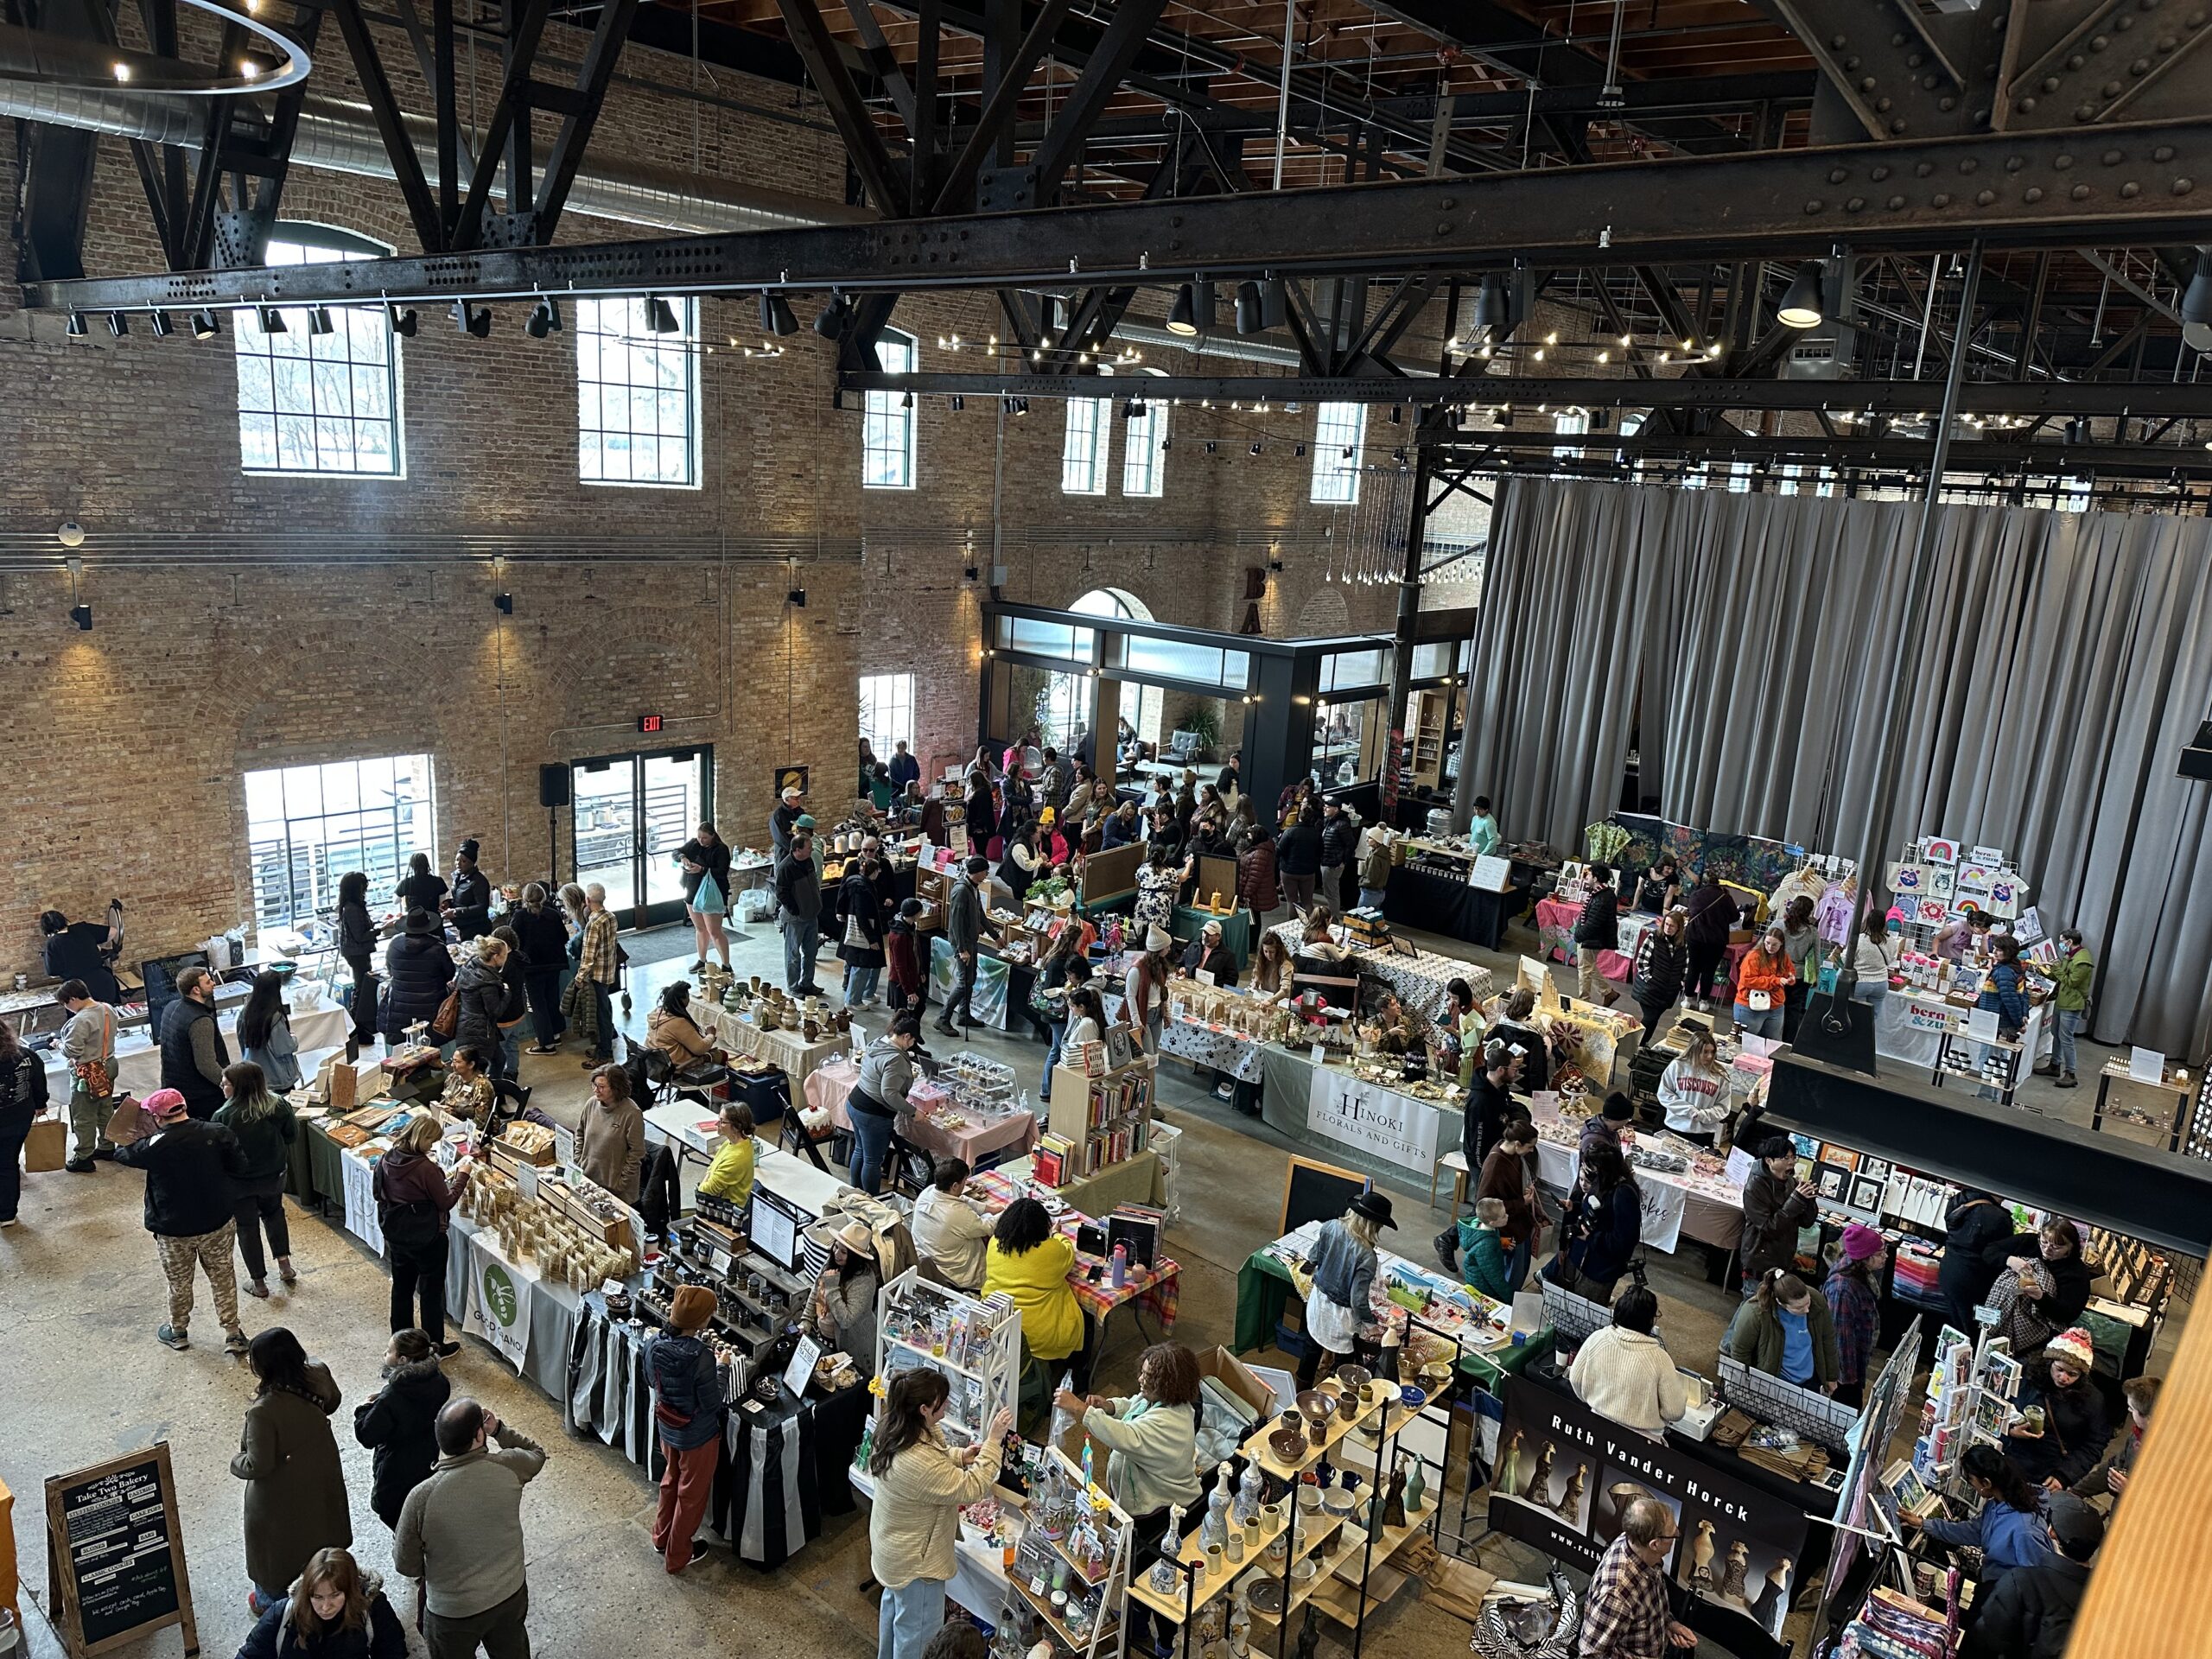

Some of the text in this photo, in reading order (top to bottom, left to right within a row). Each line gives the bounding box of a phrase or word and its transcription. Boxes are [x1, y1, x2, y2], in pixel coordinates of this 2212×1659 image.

[643, 715, 660, 732] EXIT
[1926, 1019, 1946, 1029] zu
[1677, 1077, 1719, 1097] WISCONSIN
[1339, 1092, 1402, 1132] HINOKI
[1317, 1110, 1427, 1159] FLORALS AND GIFTS
[1641, 1196, 1669, 1221] akes
[474, 1311, 496, 1332] GOOD
[1551, 1414, 1750, 1522] Ruth Vander Horck
[76, 1474, 148, 1503] Take Two Bakery
[129, 1485, 155, 1497] PASTRIES
[96, 1497, 121, 1510] COOKIES
[131, 1509, 147, 1519] CAKE
[83, 1543, 105, 1553] SCONES
[1550, 1530, 1603, 1562] www.ruth
[83, 1560, 133, 1581] CLASSIC COOKIES
